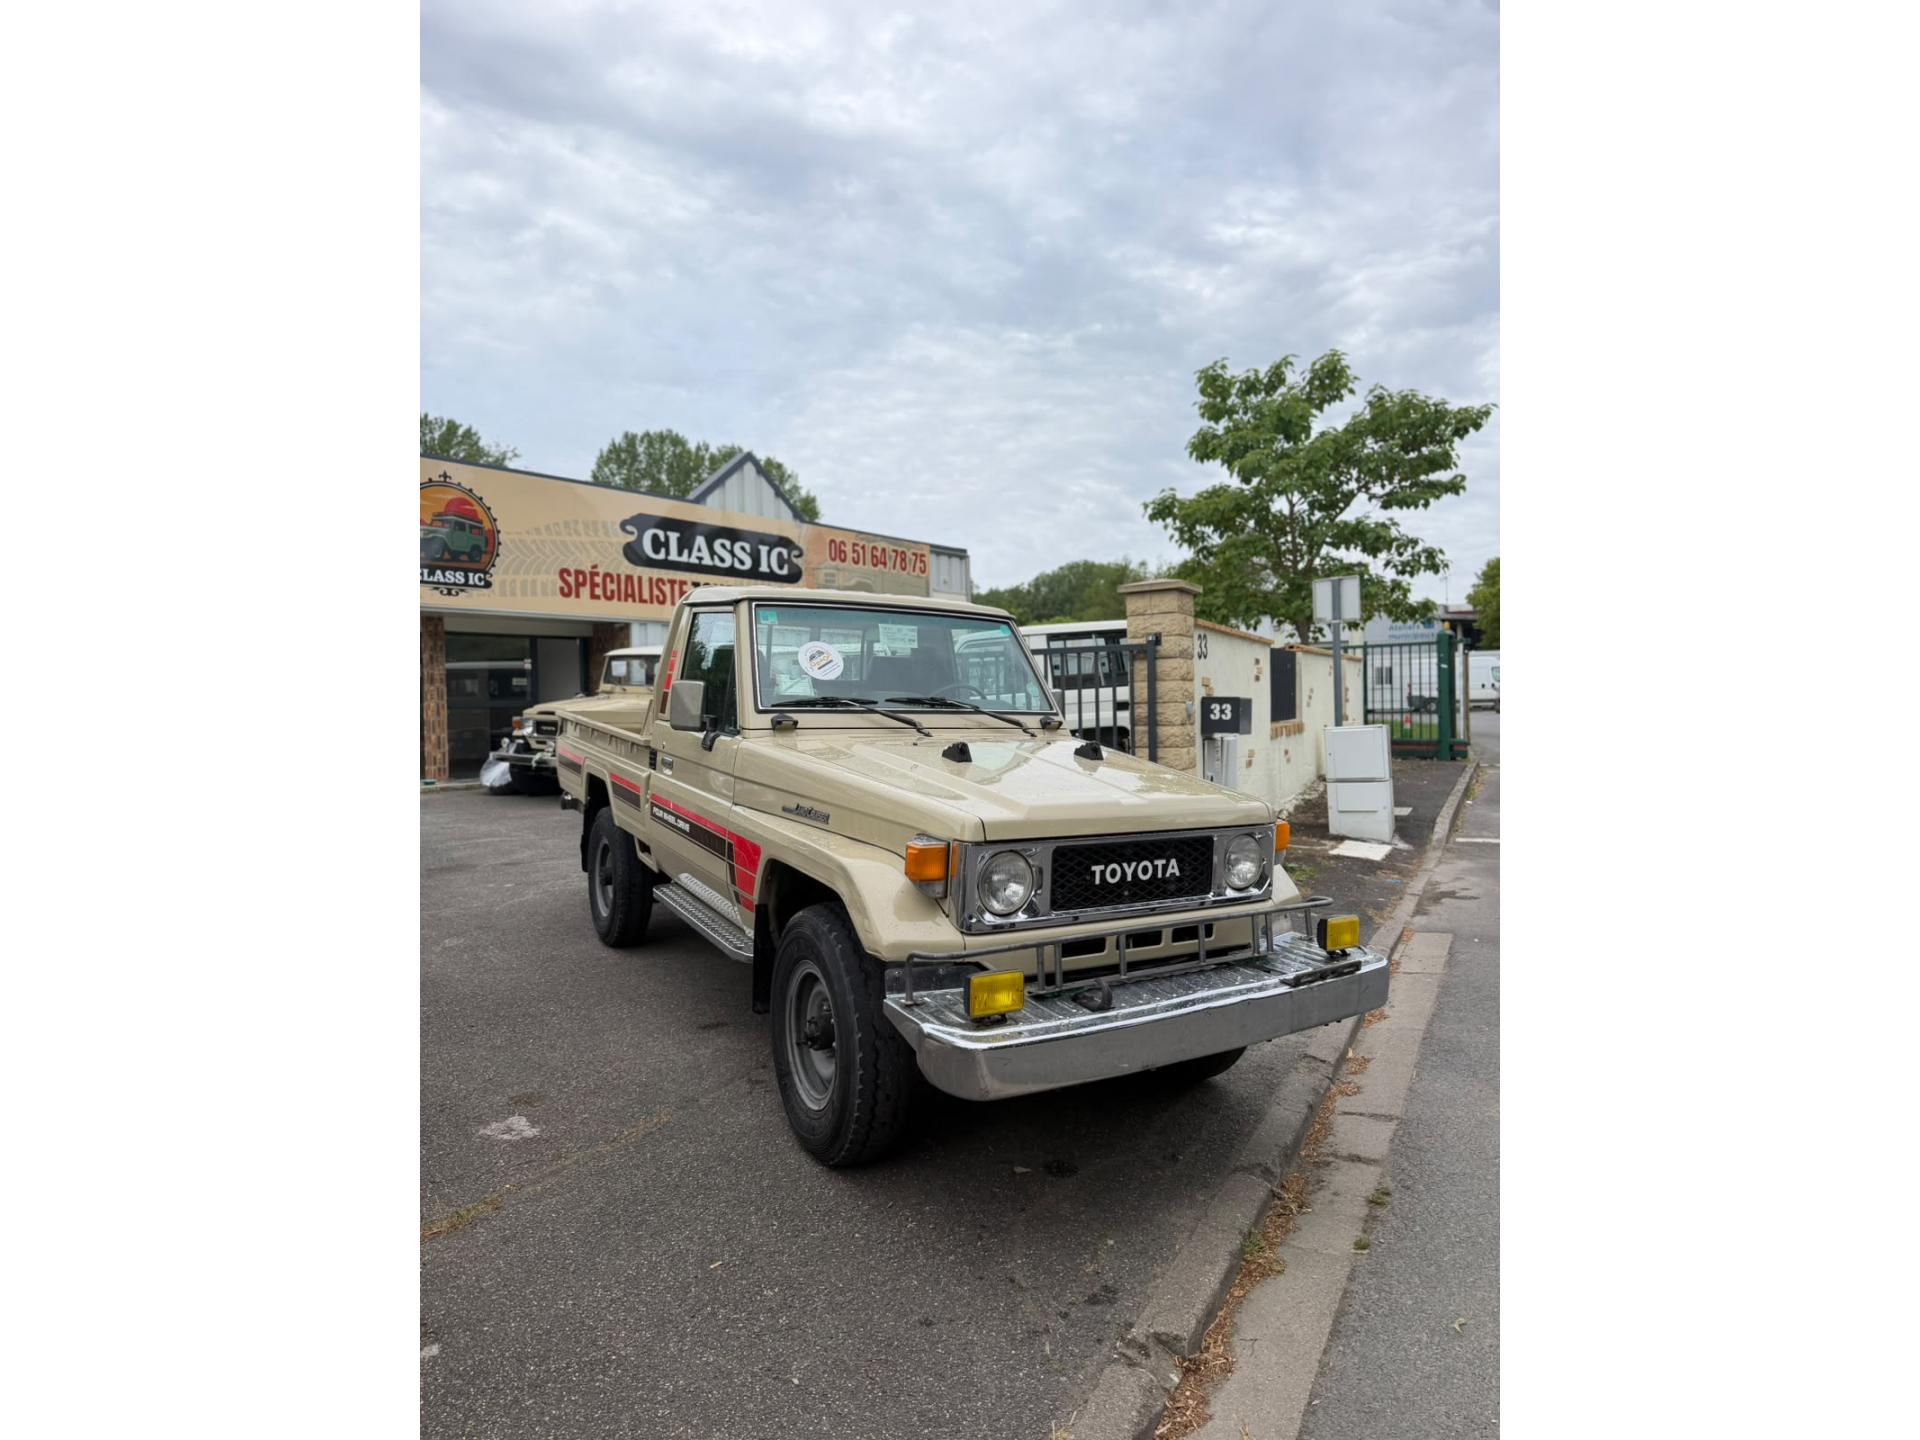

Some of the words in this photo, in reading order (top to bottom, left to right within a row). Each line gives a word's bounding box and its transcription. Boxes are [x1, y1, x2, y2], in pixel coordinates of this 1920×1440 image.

[641, 527, 752, 571] CLASS
[758, 544, 790, 576] IC
[828, 538, 847, 563] 06
[851, 541, 866, 566] 51
[870, 544, 888, 569] 64
[892, 548, 908, 573] 78
[911, 551, 928, 576] 75
[468, 572, 485, 586] IC
[1197, 634, 1208, 660] 33
[1209, 702, 1232, 720] 33
[1091, 858, 1180, 885] TOYOTA
